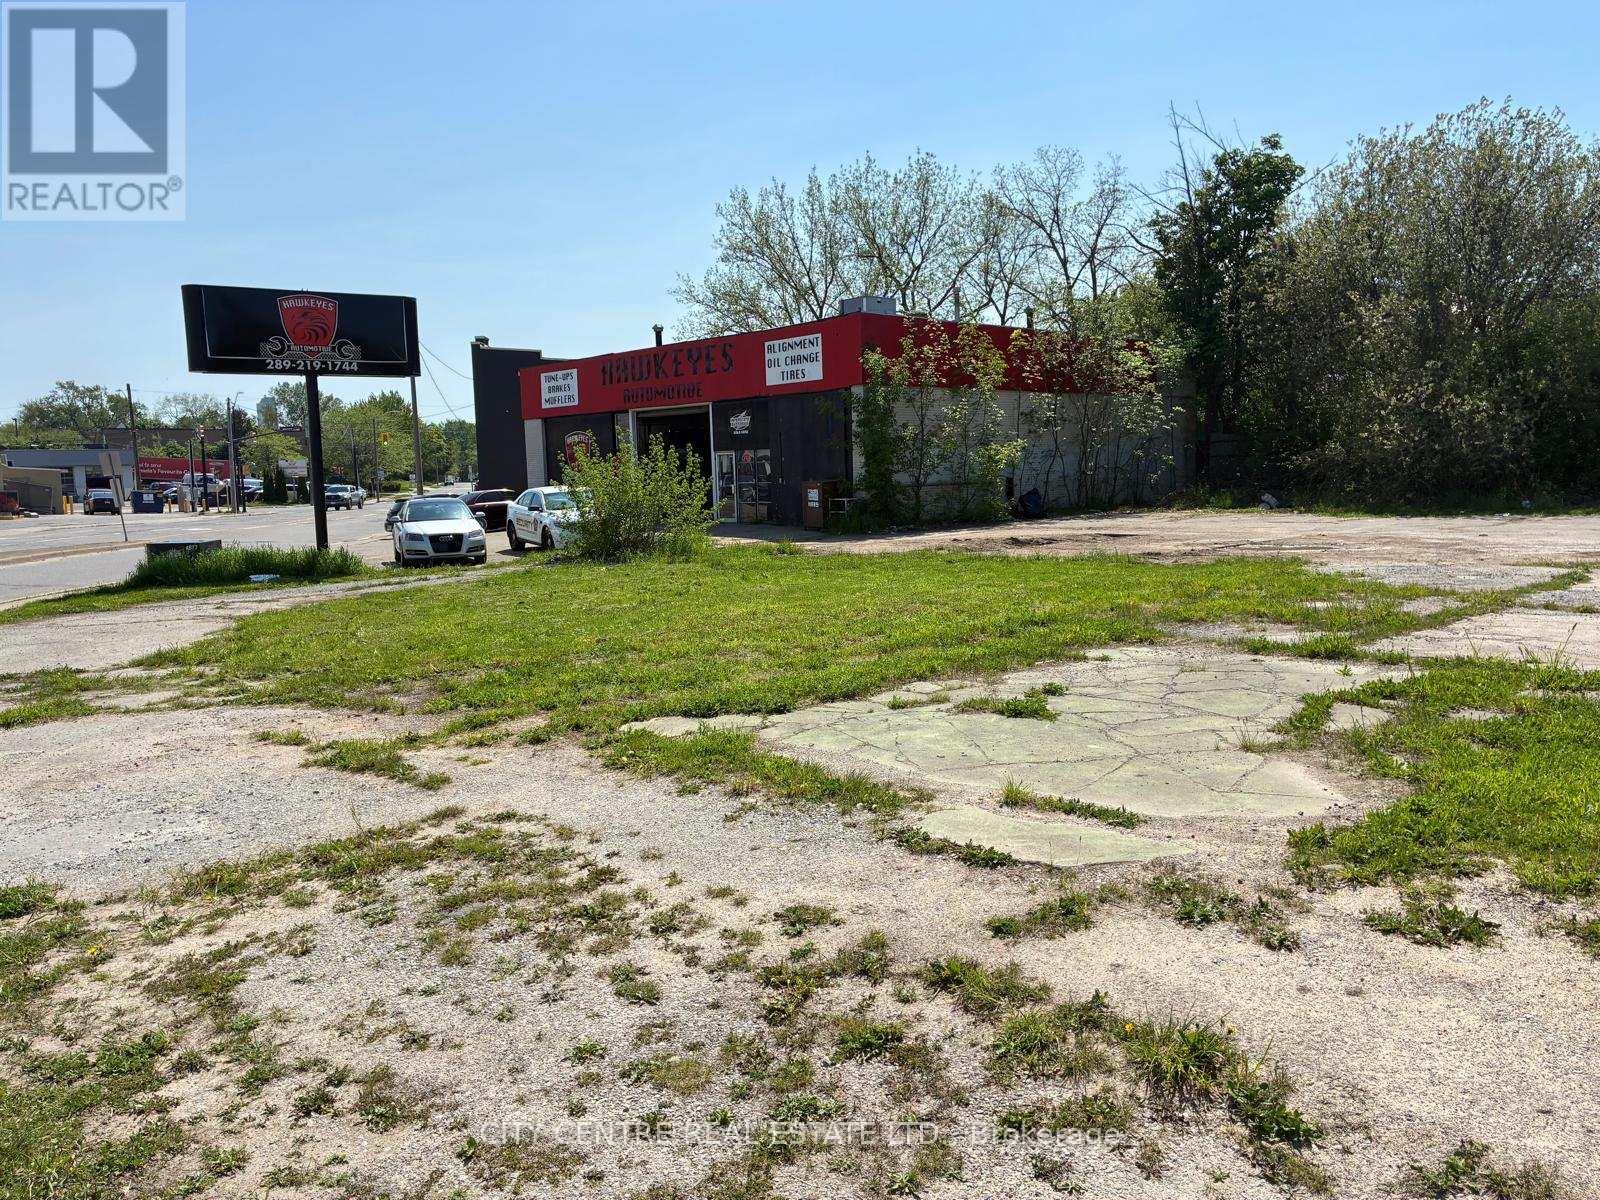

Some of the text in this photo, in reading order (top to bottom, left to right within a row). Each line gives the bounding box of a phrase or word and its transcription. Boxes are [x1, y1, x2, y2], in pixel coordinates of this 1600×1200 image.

[282, 299, 334, 311] HAWKEYES
[767, 336, 820, 354] ALIGNMENT
[266, 360, 359, 371] 289-219-1744
[601, 343, 734, 386] HAWKEYES
[767, 352, 820, 368] OIL CHANGE
[544, 372, 574, 383] TUNE-UPS
[780, 368, 806, 381] TIRES
[547, 384, 571, 394] BRAKES
[623, 382, 703, 403] AUTOMOTIVE
[544, 394, 576, 405] MUFFLERS
